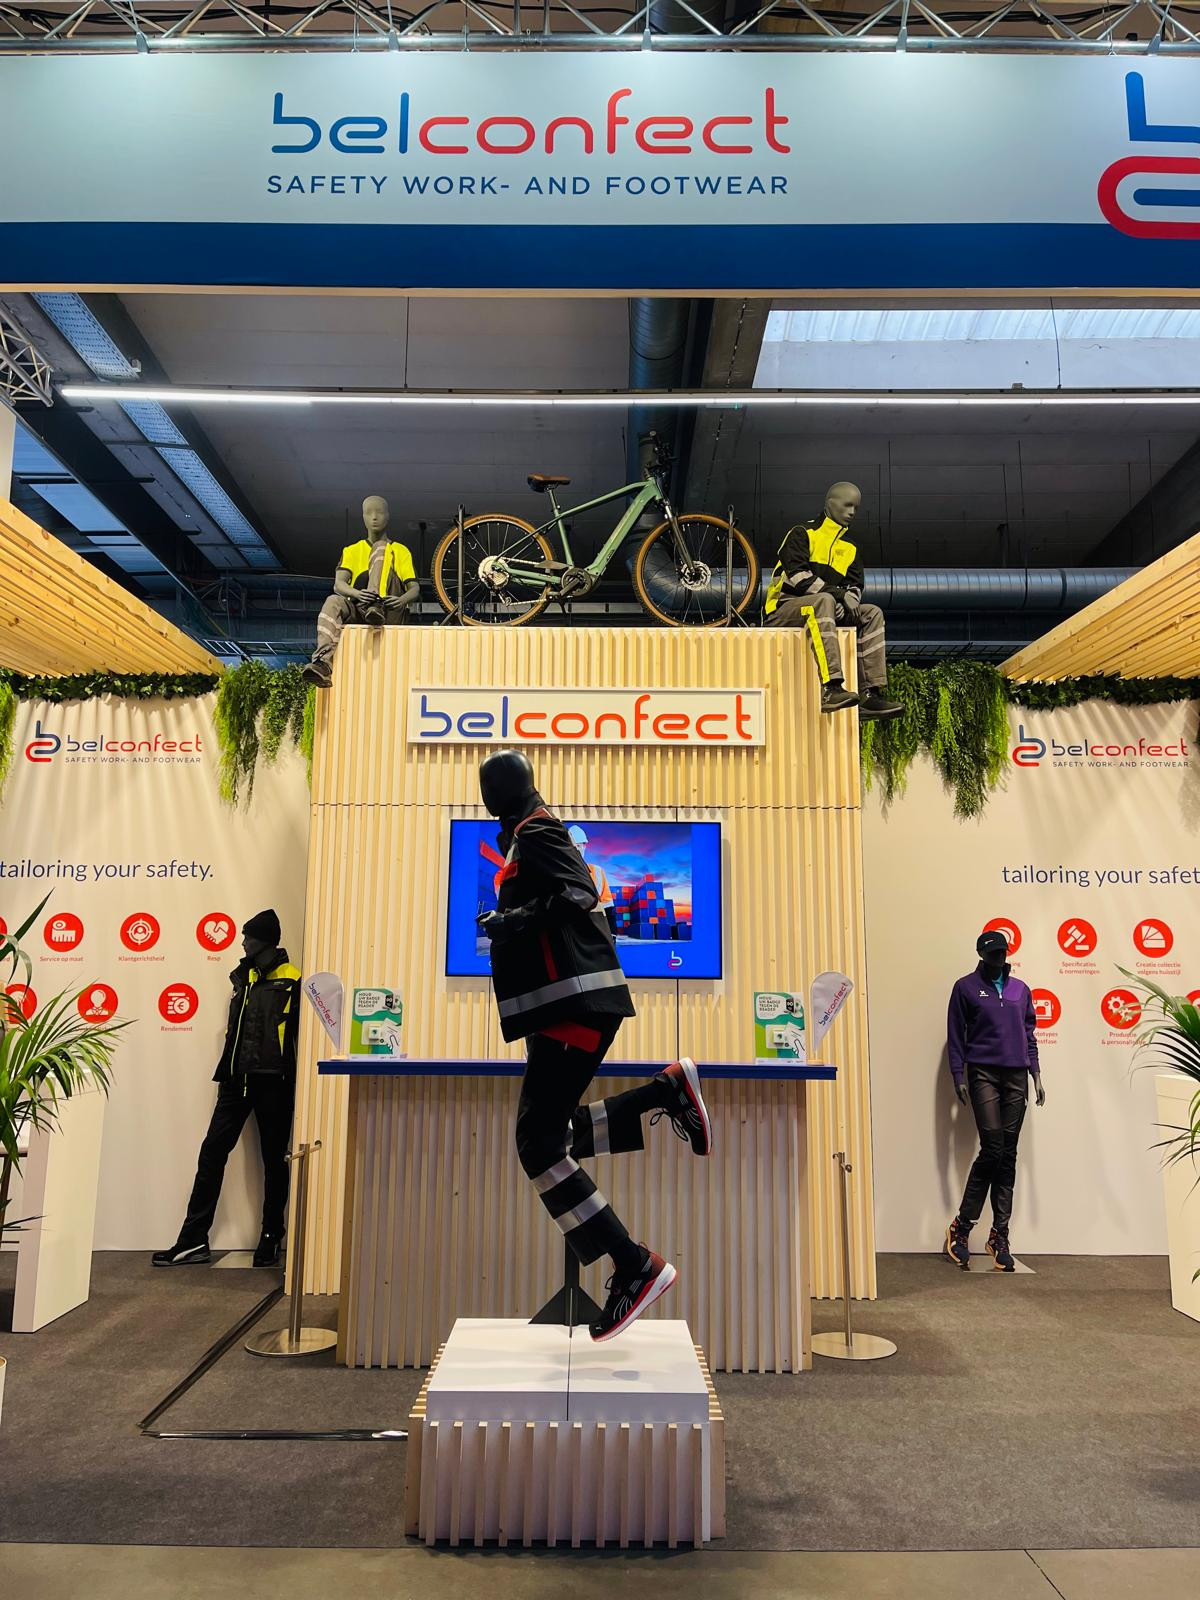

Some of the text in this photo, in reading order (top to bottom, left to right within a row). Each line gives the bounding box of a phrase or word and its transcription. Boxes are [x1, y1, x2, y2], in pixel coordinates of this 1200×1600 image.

[271, 87, 791, 154] belconfect
[267, 175, 789, 195] SAFETY WORK- AND FOOTWEAR
[420, 694, 752, 740] belconfect
[66, 734, 203, 753] belconfect
[1052, 738, 1189, 757] belconfect
[0, 859, 214, 882] tailoring your safety.
[1002, 865, 1089, 887] tailoring
[1095, 868, 1143, 887] your
